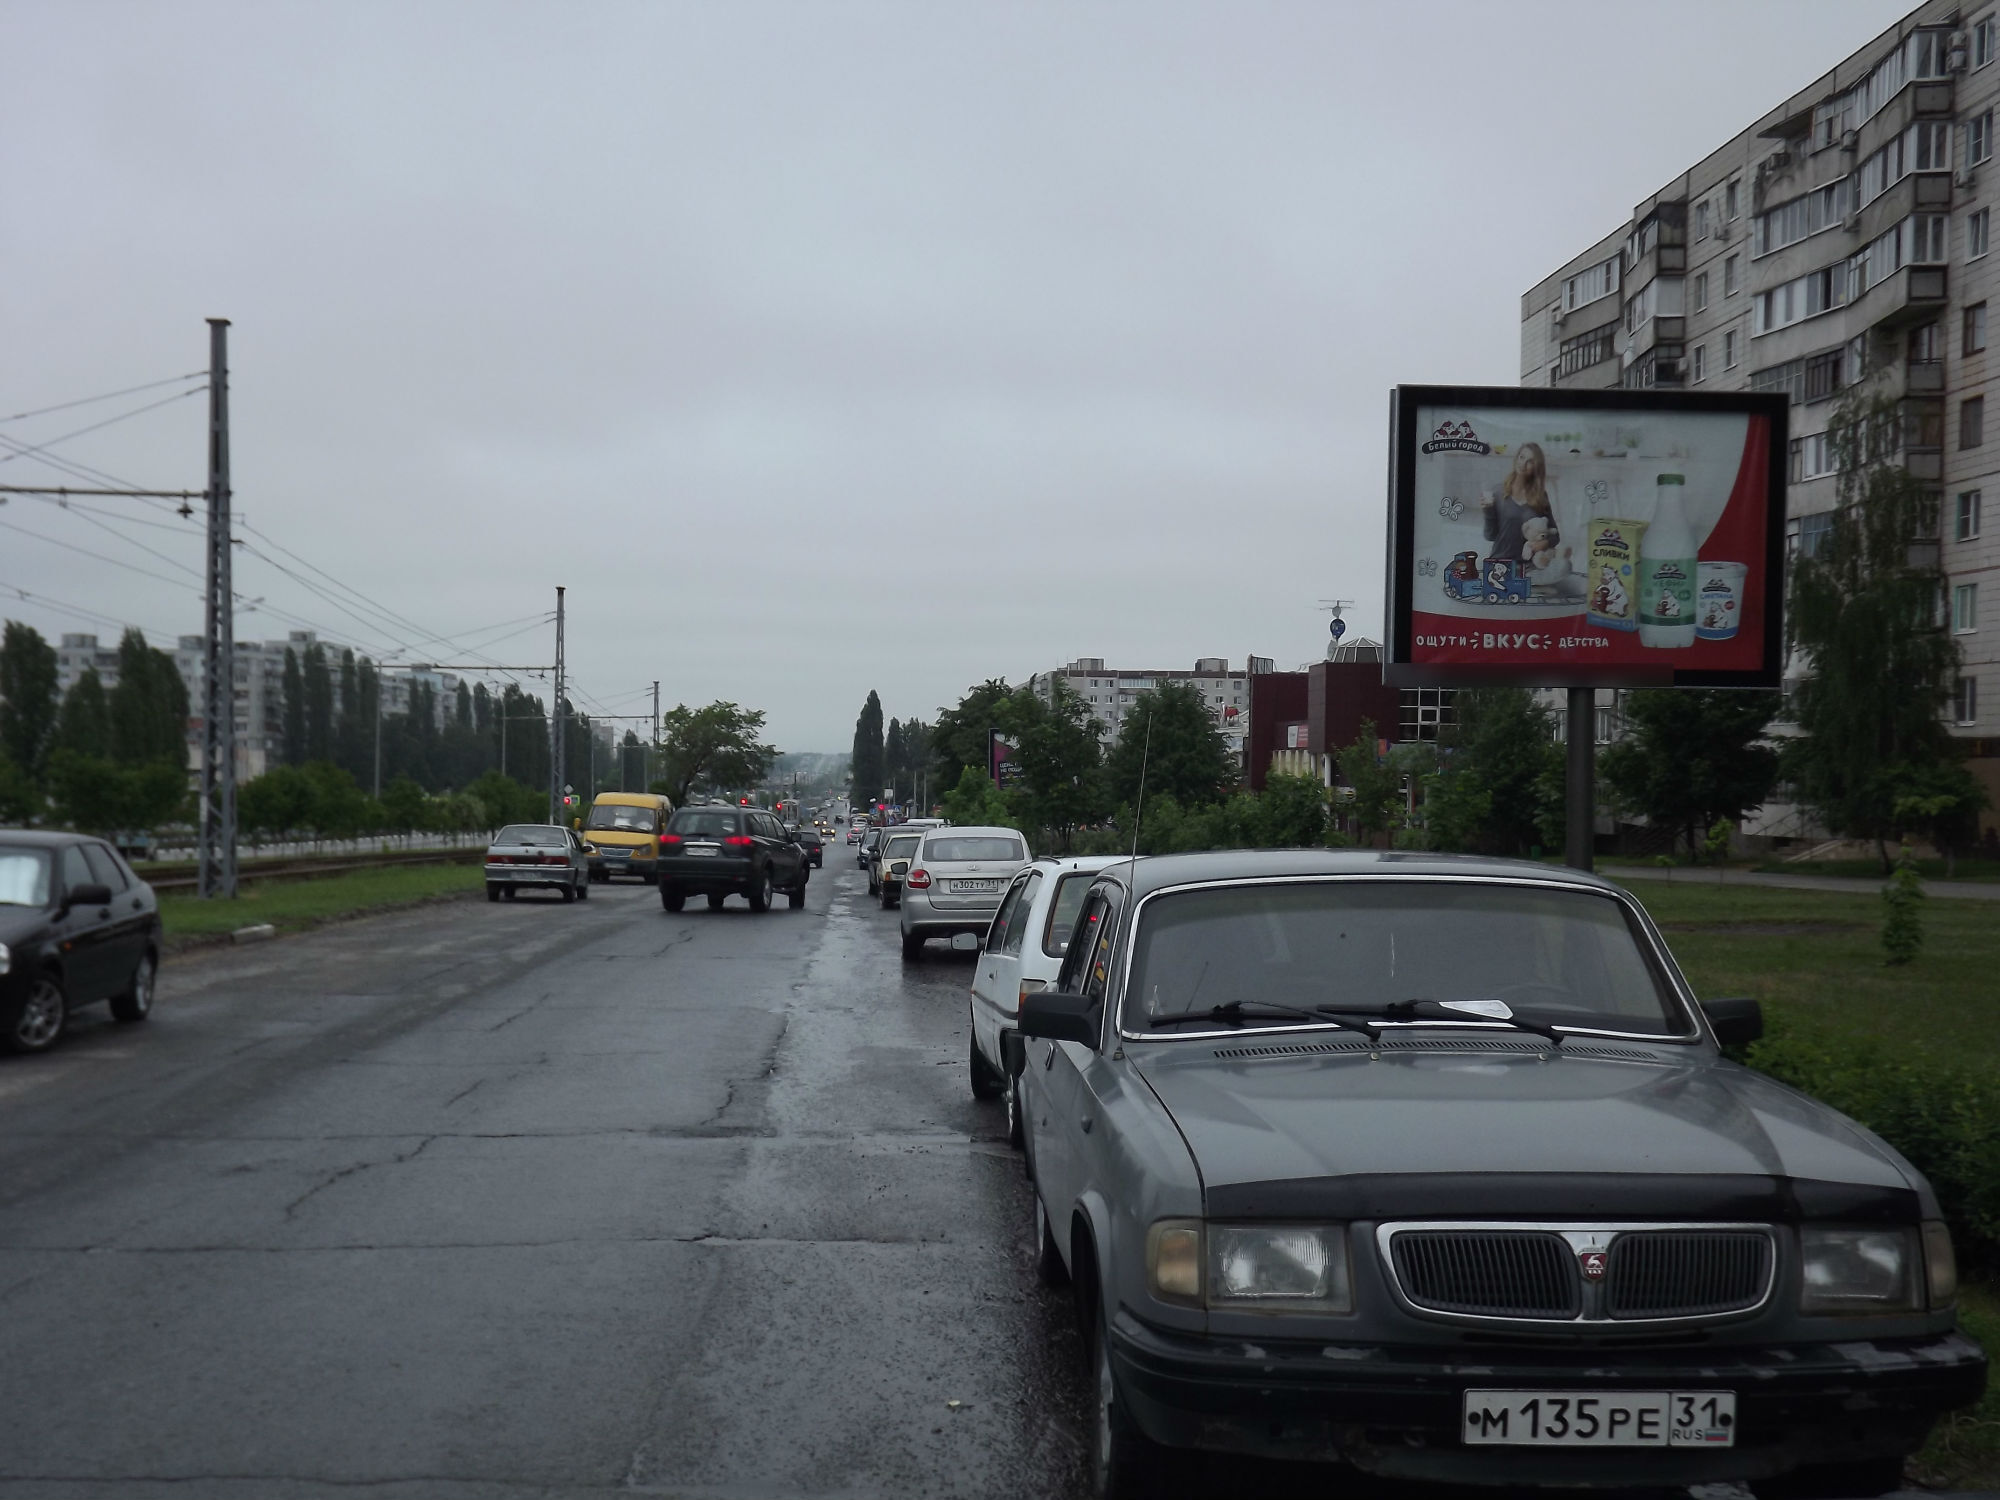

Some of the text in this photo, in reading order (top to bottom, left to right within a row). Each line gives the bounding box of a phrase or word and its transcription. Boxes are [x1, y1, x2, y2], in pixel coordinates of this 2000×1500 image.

[1428, 442, 1484, 453] Белый город
[1592, 548, 1631, 562] СЛИВКИ
[1415, 633, 1610, 649] ОЩУТИ ВКУС ДЕТСТВА
[1676, 1396, 1718, 1428] 31
[1671, 1428, 1704, 1441] RUS
